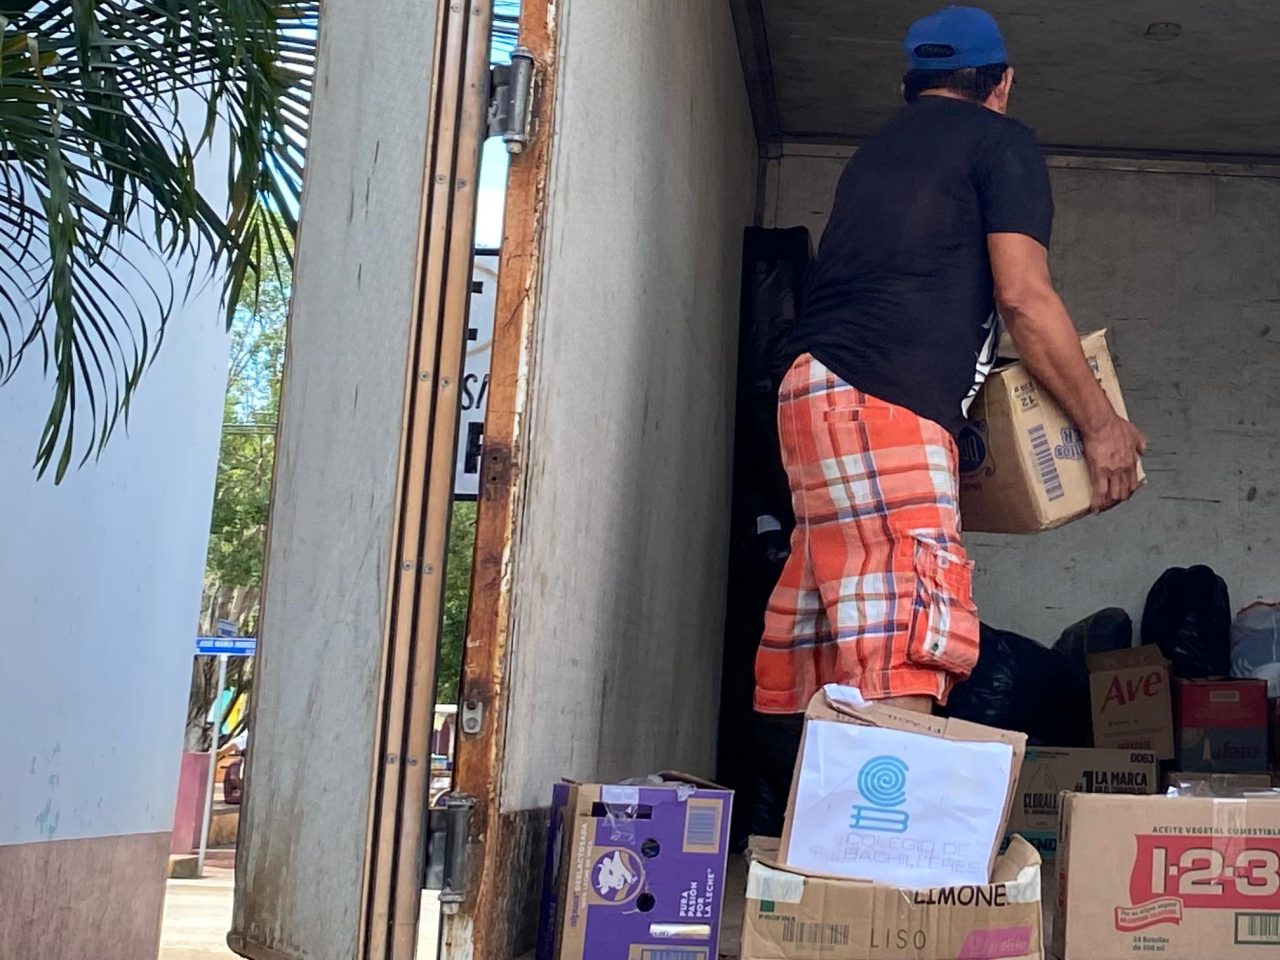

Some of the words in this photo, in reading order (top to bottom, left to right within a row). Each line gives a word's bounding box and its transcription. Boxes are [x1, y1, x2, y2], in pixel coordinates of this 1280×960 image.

[1095, 771, 1108, 785] LA
[1111, 771, 1148, 786] MARCA
[1024, 793, 1057, 809] CLORALE
[1152, 826, 1182, 834] ACEITE
[1185, 826, 1224, 835] VEGETAL
[680, 890, 689, 917] PURA
[696, 897, 704, 917] POR
[703, 905, 711, 917] LA
[870, 927, 927, 950] LISO
